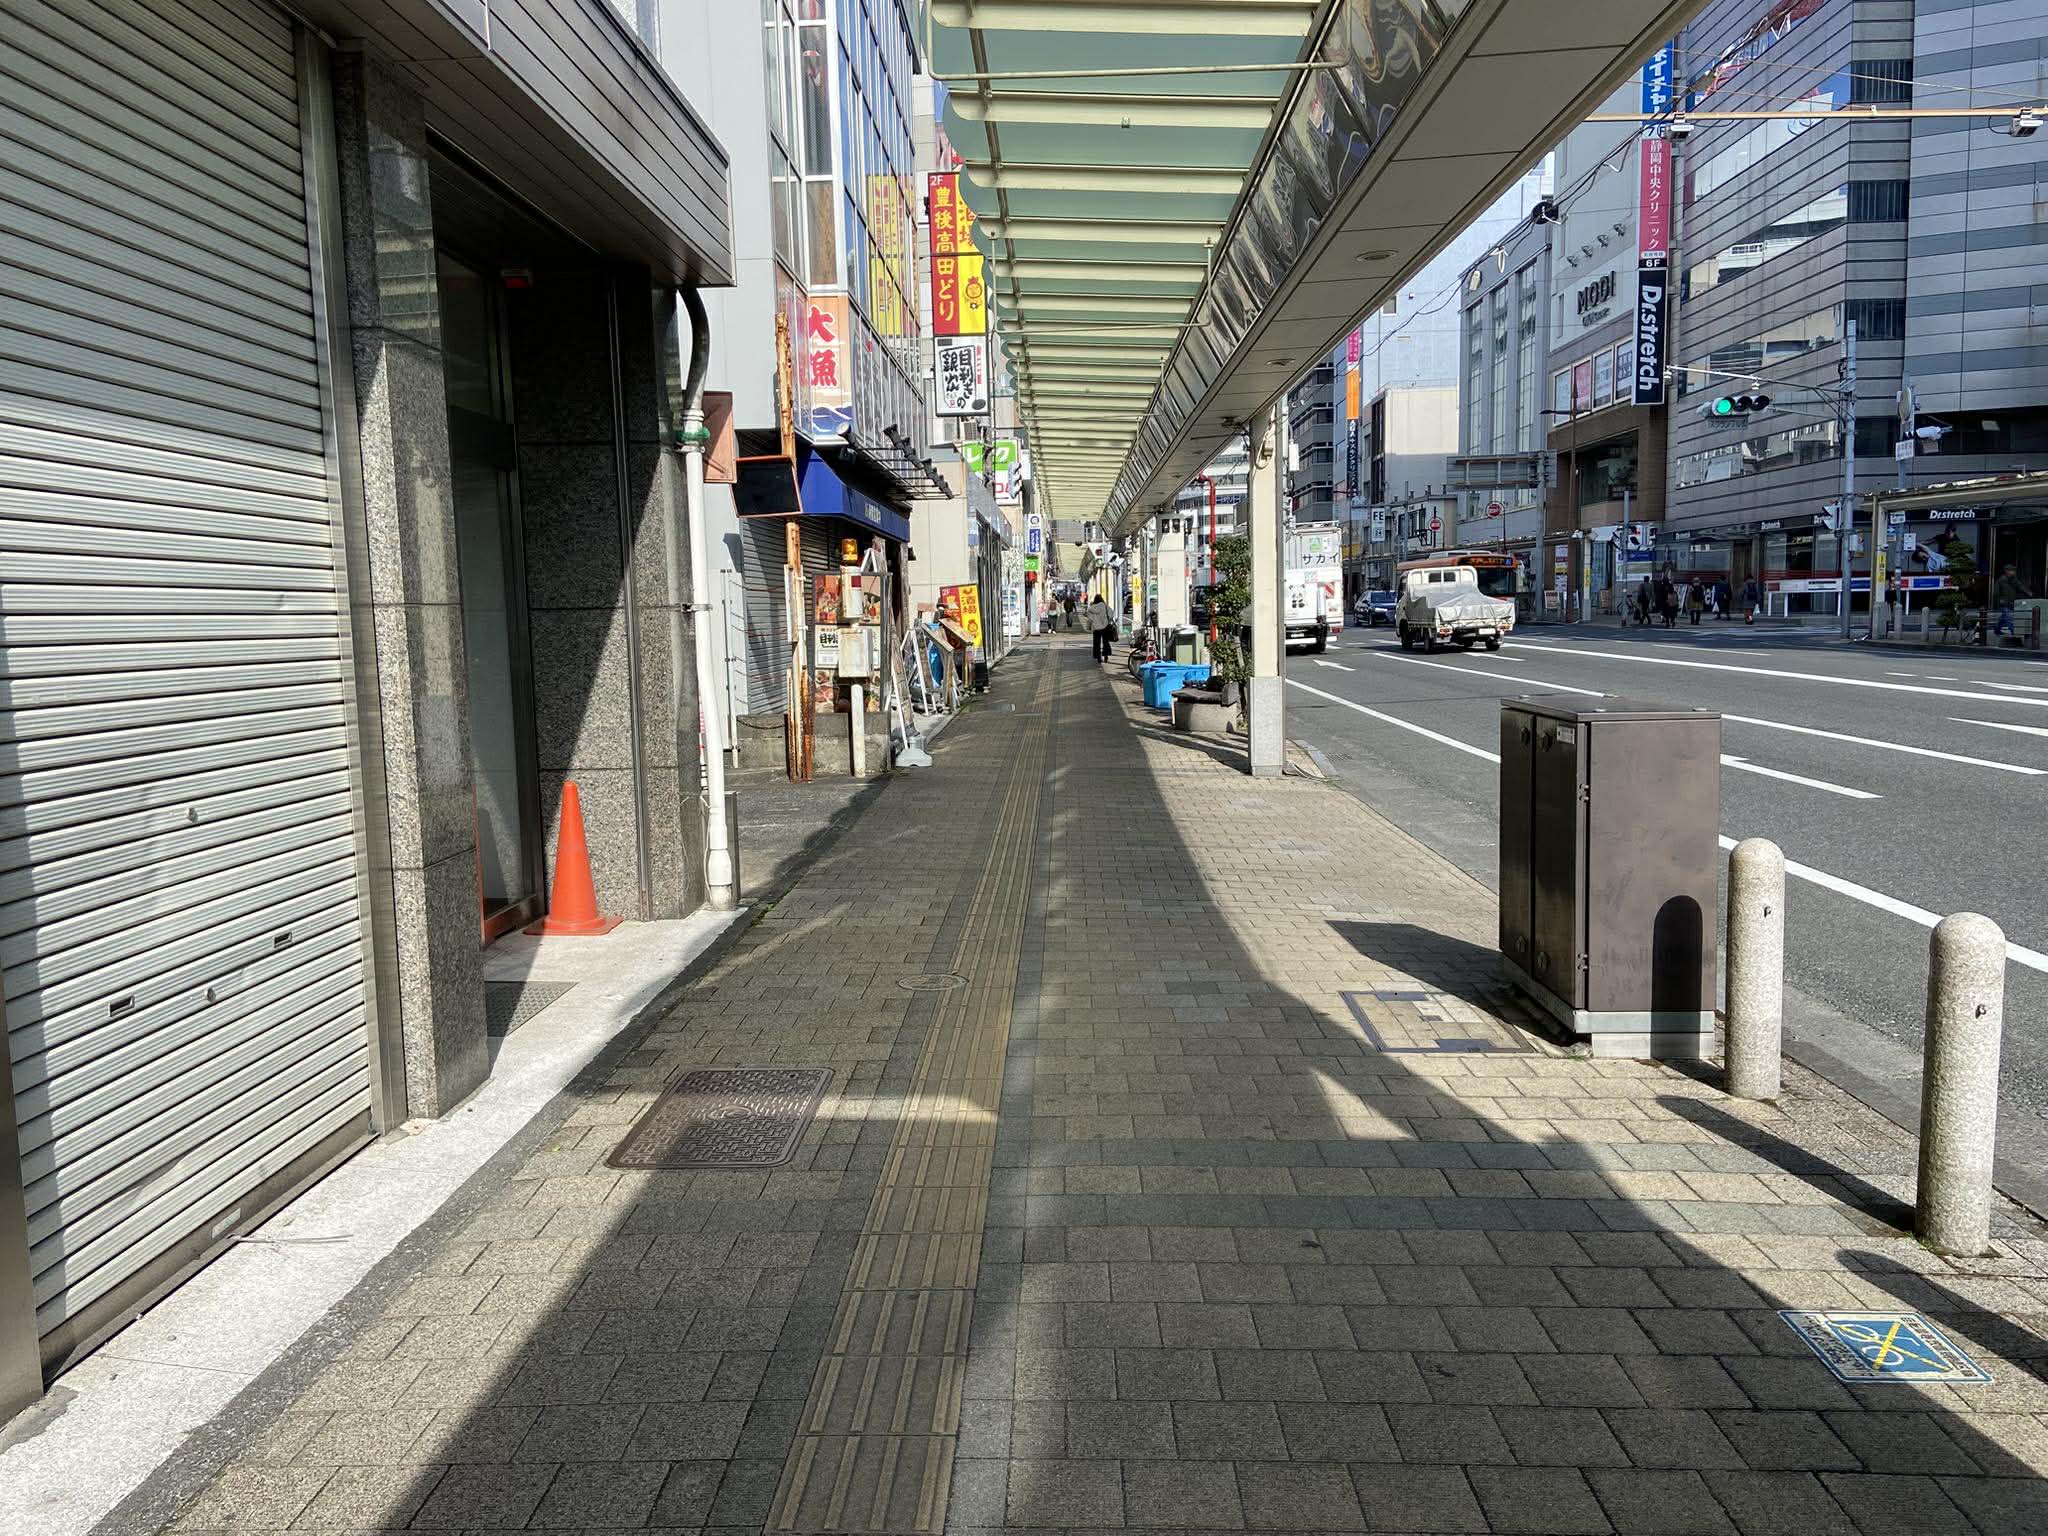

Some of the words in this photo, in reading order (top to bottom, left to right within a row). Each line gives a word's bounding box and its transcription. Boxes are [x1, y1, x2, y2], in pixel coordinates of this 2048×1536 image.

[930, 175, 943, 186] 2F
[1648, 140, 1662, 250] 静岡中央クリニック
[933, 187, 954, 321] 豊後高田どり
[1646, 259, 1661, 268] 6F
[1577, 271, 1616, 315] MODI
[1639, 285, 1663, 391] Dr.stretch
[1303, 553, 1338, 565] サカイ
